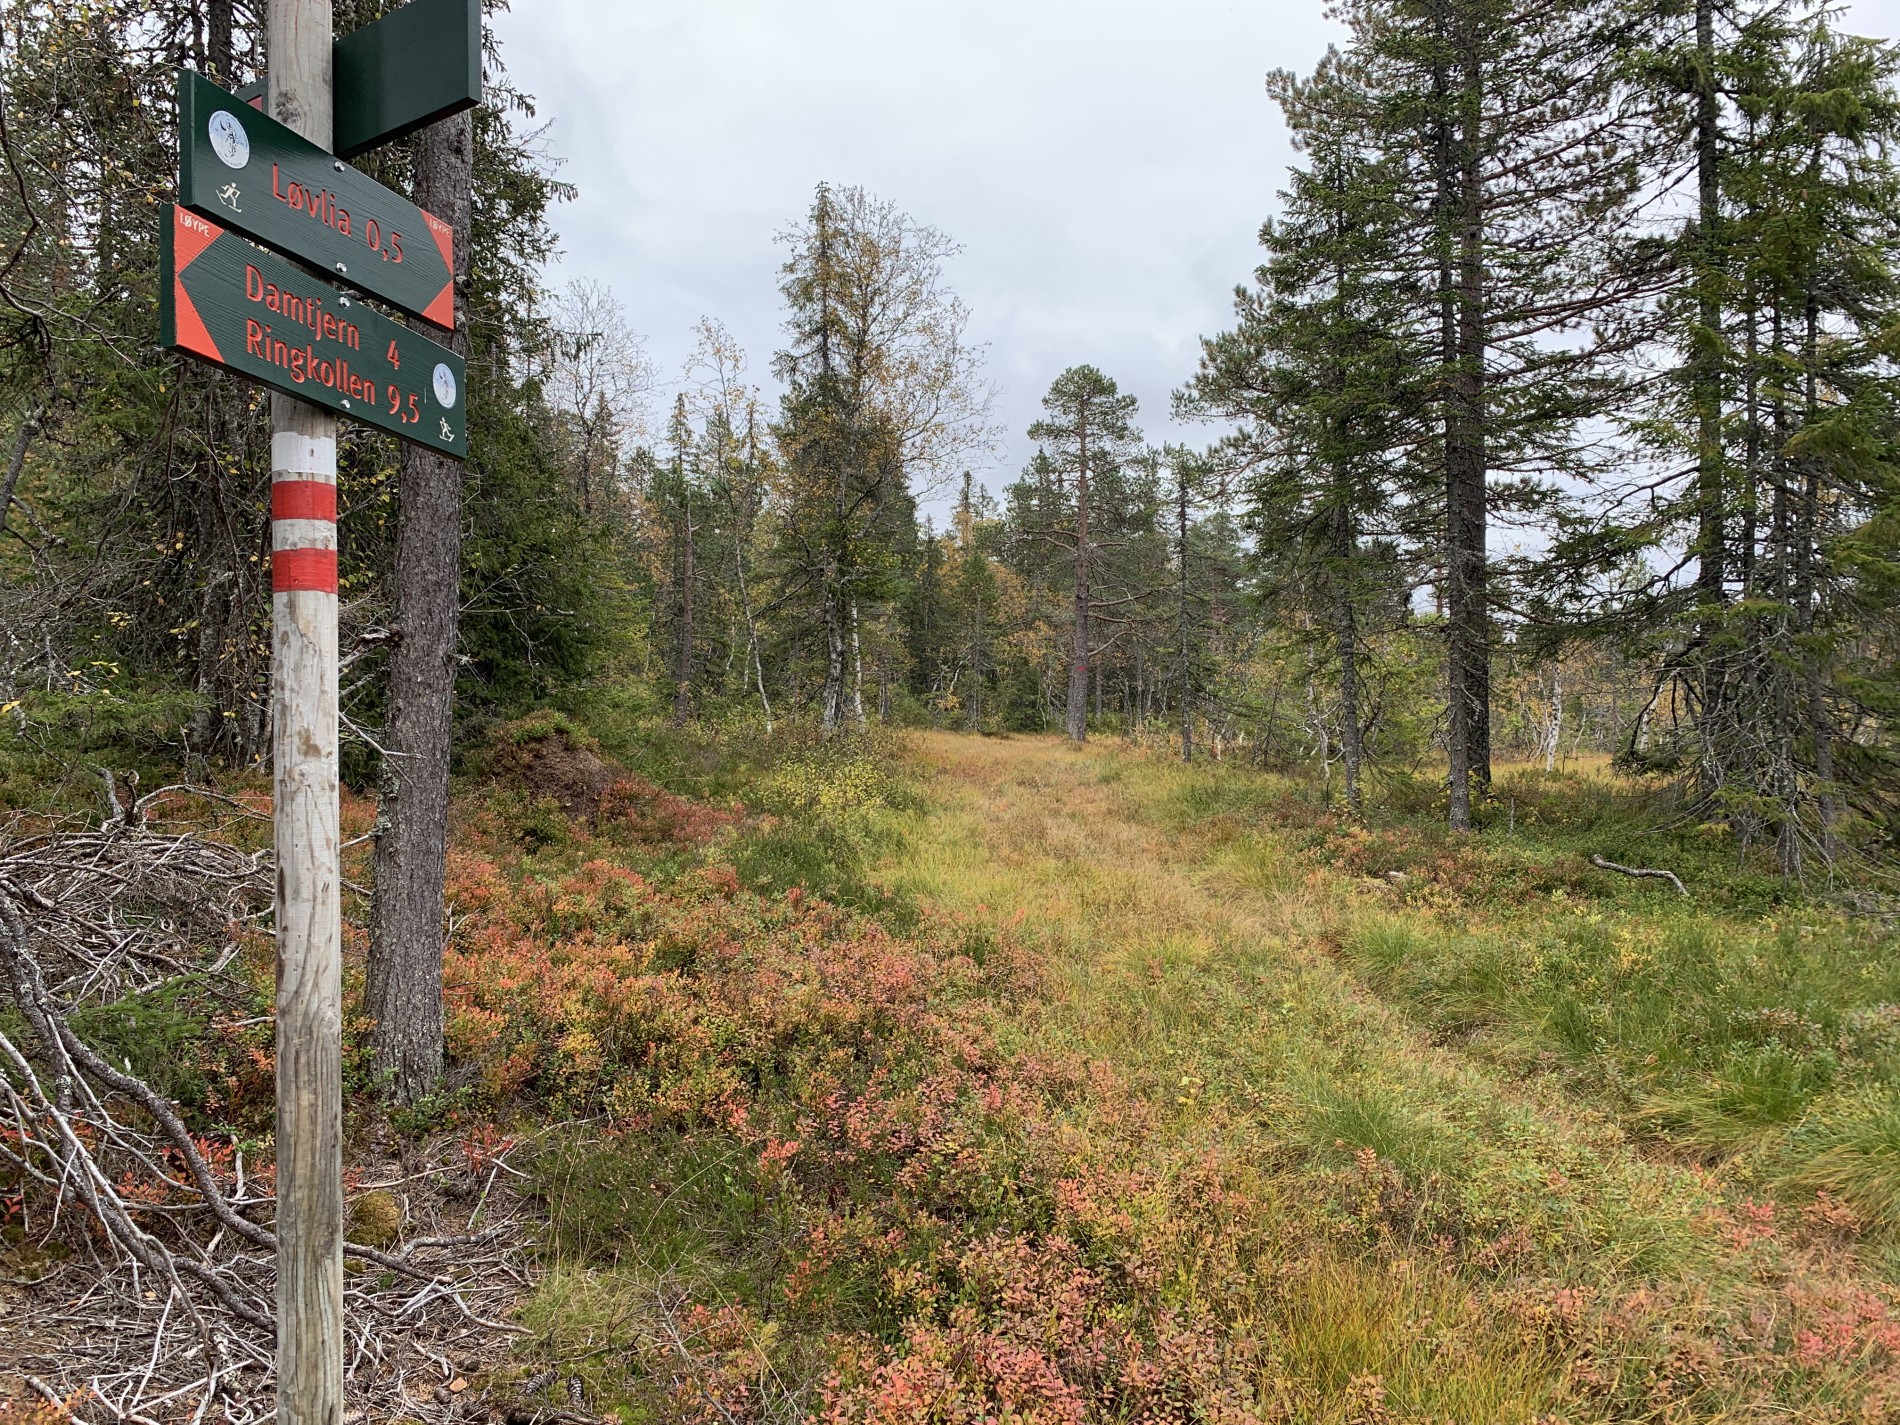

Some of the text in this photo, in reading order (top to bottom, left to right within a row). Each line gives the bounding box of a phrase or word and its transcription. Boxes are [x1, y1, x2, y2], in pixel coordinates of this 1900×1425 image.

[180, 212, 210, 237] LØYPE
[272, 163, 403, 264] Løvlia 0,5
[246, 263, 400, 370] Damtjern 4
[246, 318, 376, 405] Ringkollen
[387, 384, 420, 423] 9,5
